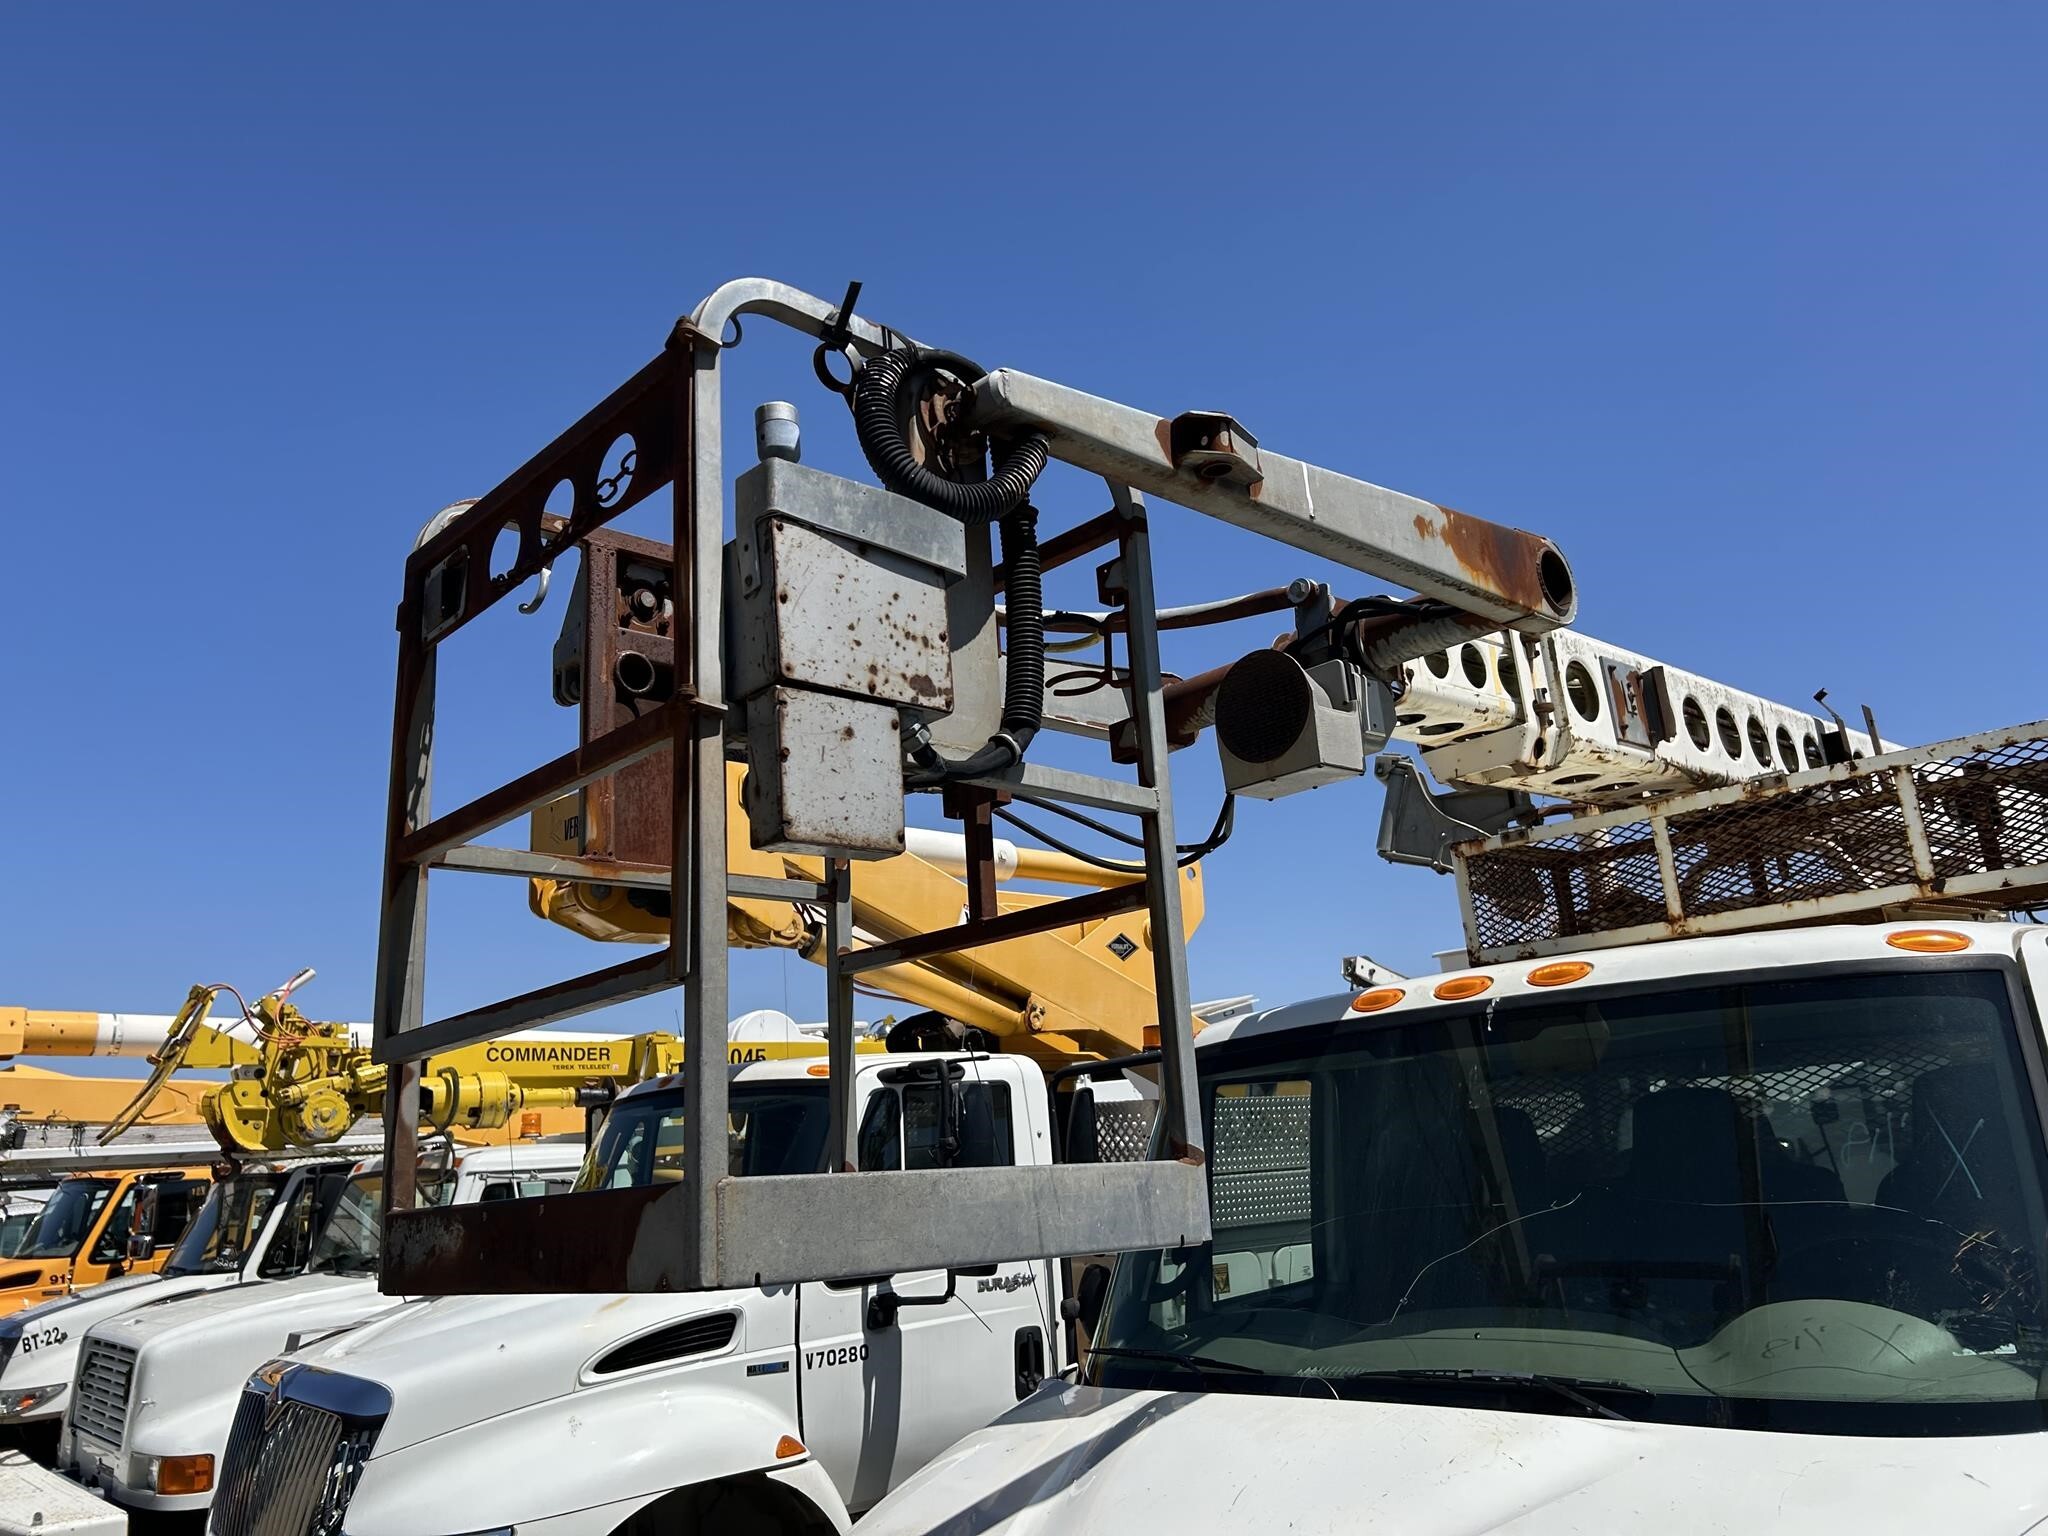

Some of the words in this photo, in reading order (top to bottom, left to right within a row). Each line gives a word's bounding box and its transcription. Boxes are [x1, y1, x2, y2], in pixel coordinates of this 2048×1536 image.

[486, 1047, 611, 1062] COMMANDER
[22, 1326, 60, 1354] BT-22
[805, 1343, 870, 1371] V70280
